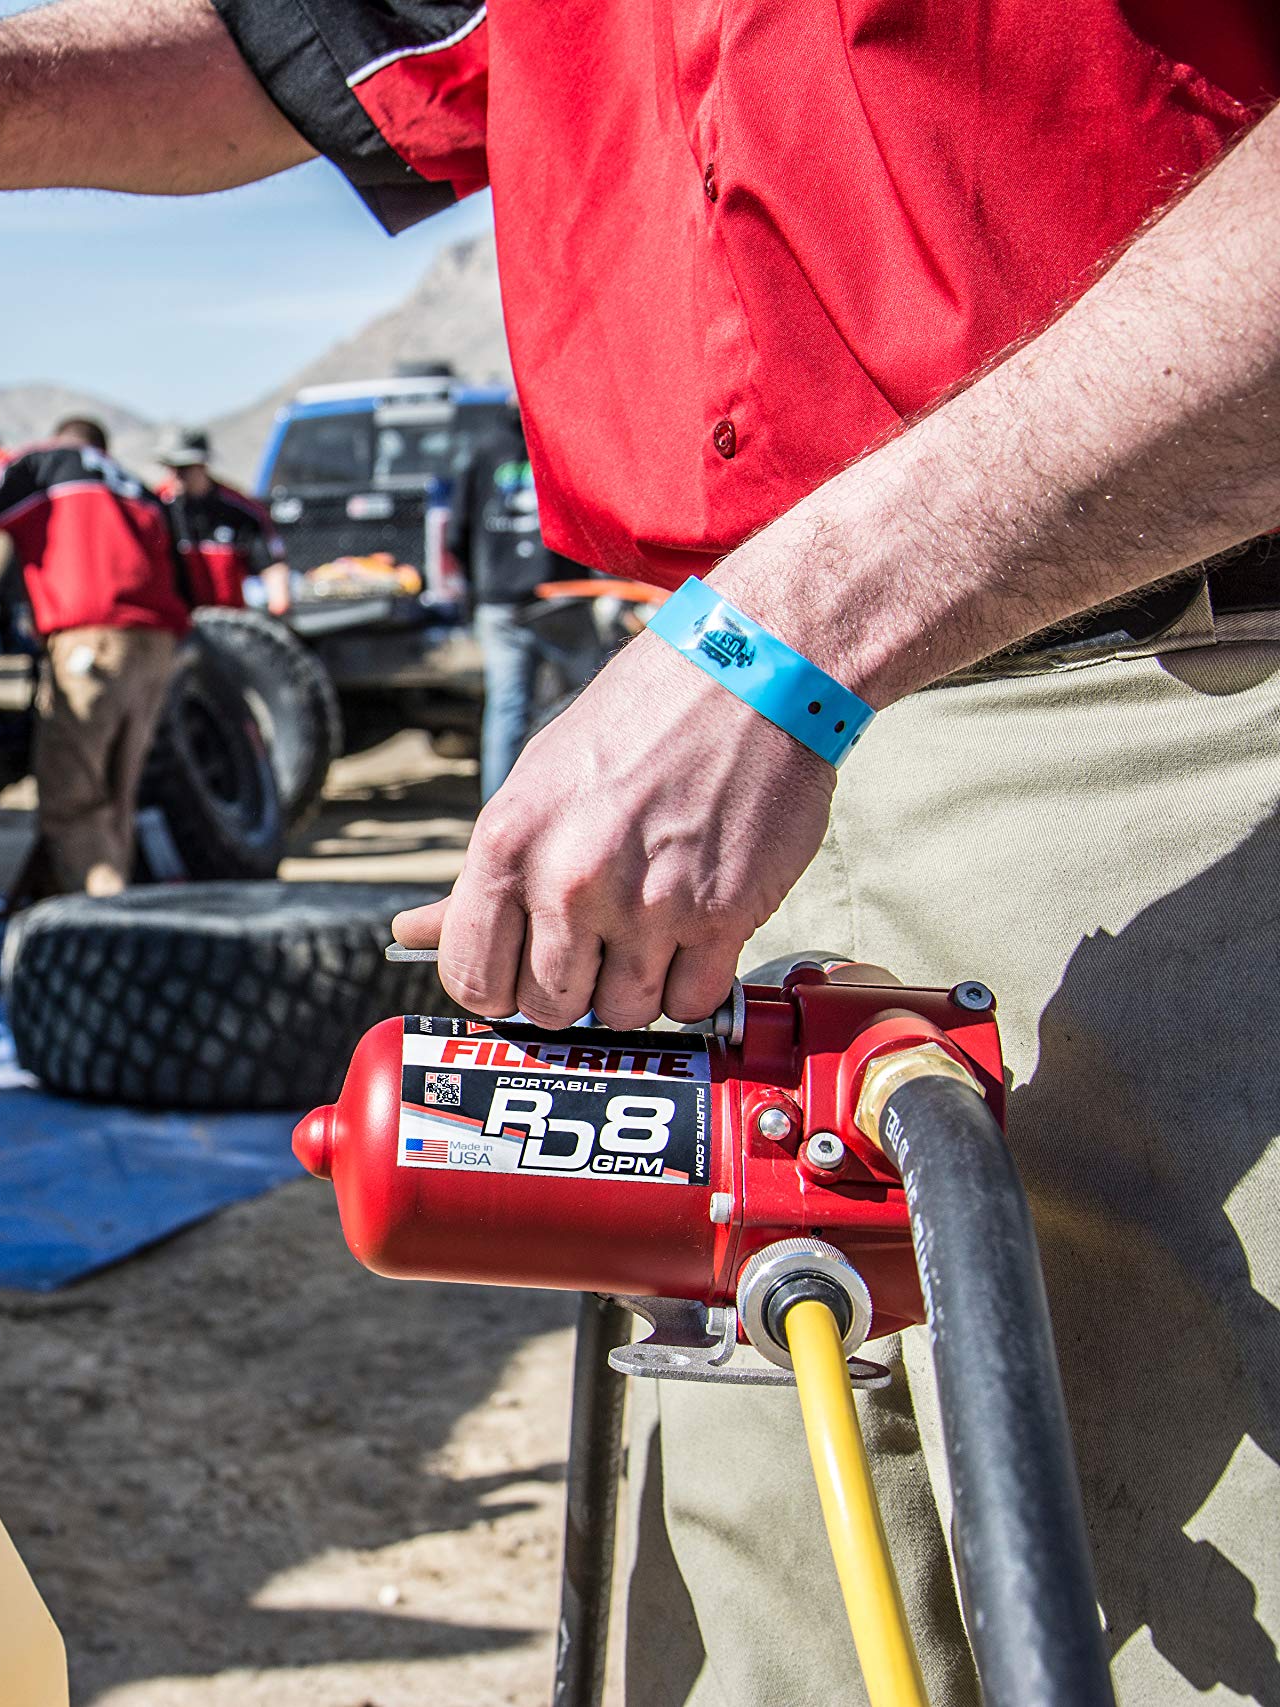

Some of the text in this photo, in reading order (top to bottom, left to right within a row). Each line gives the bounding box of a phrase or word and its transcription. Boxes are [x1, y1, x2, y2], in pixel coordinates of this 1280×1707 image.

[495, 1076, 608, 1094] PORTABLE
[695, 1087, 705, 1178] FILLRITE.COM
[449, 1140, 493, 1153] Made in
[448, 1151, 492, 1167] USA
[592, 1155, 665, 1175] GPM
